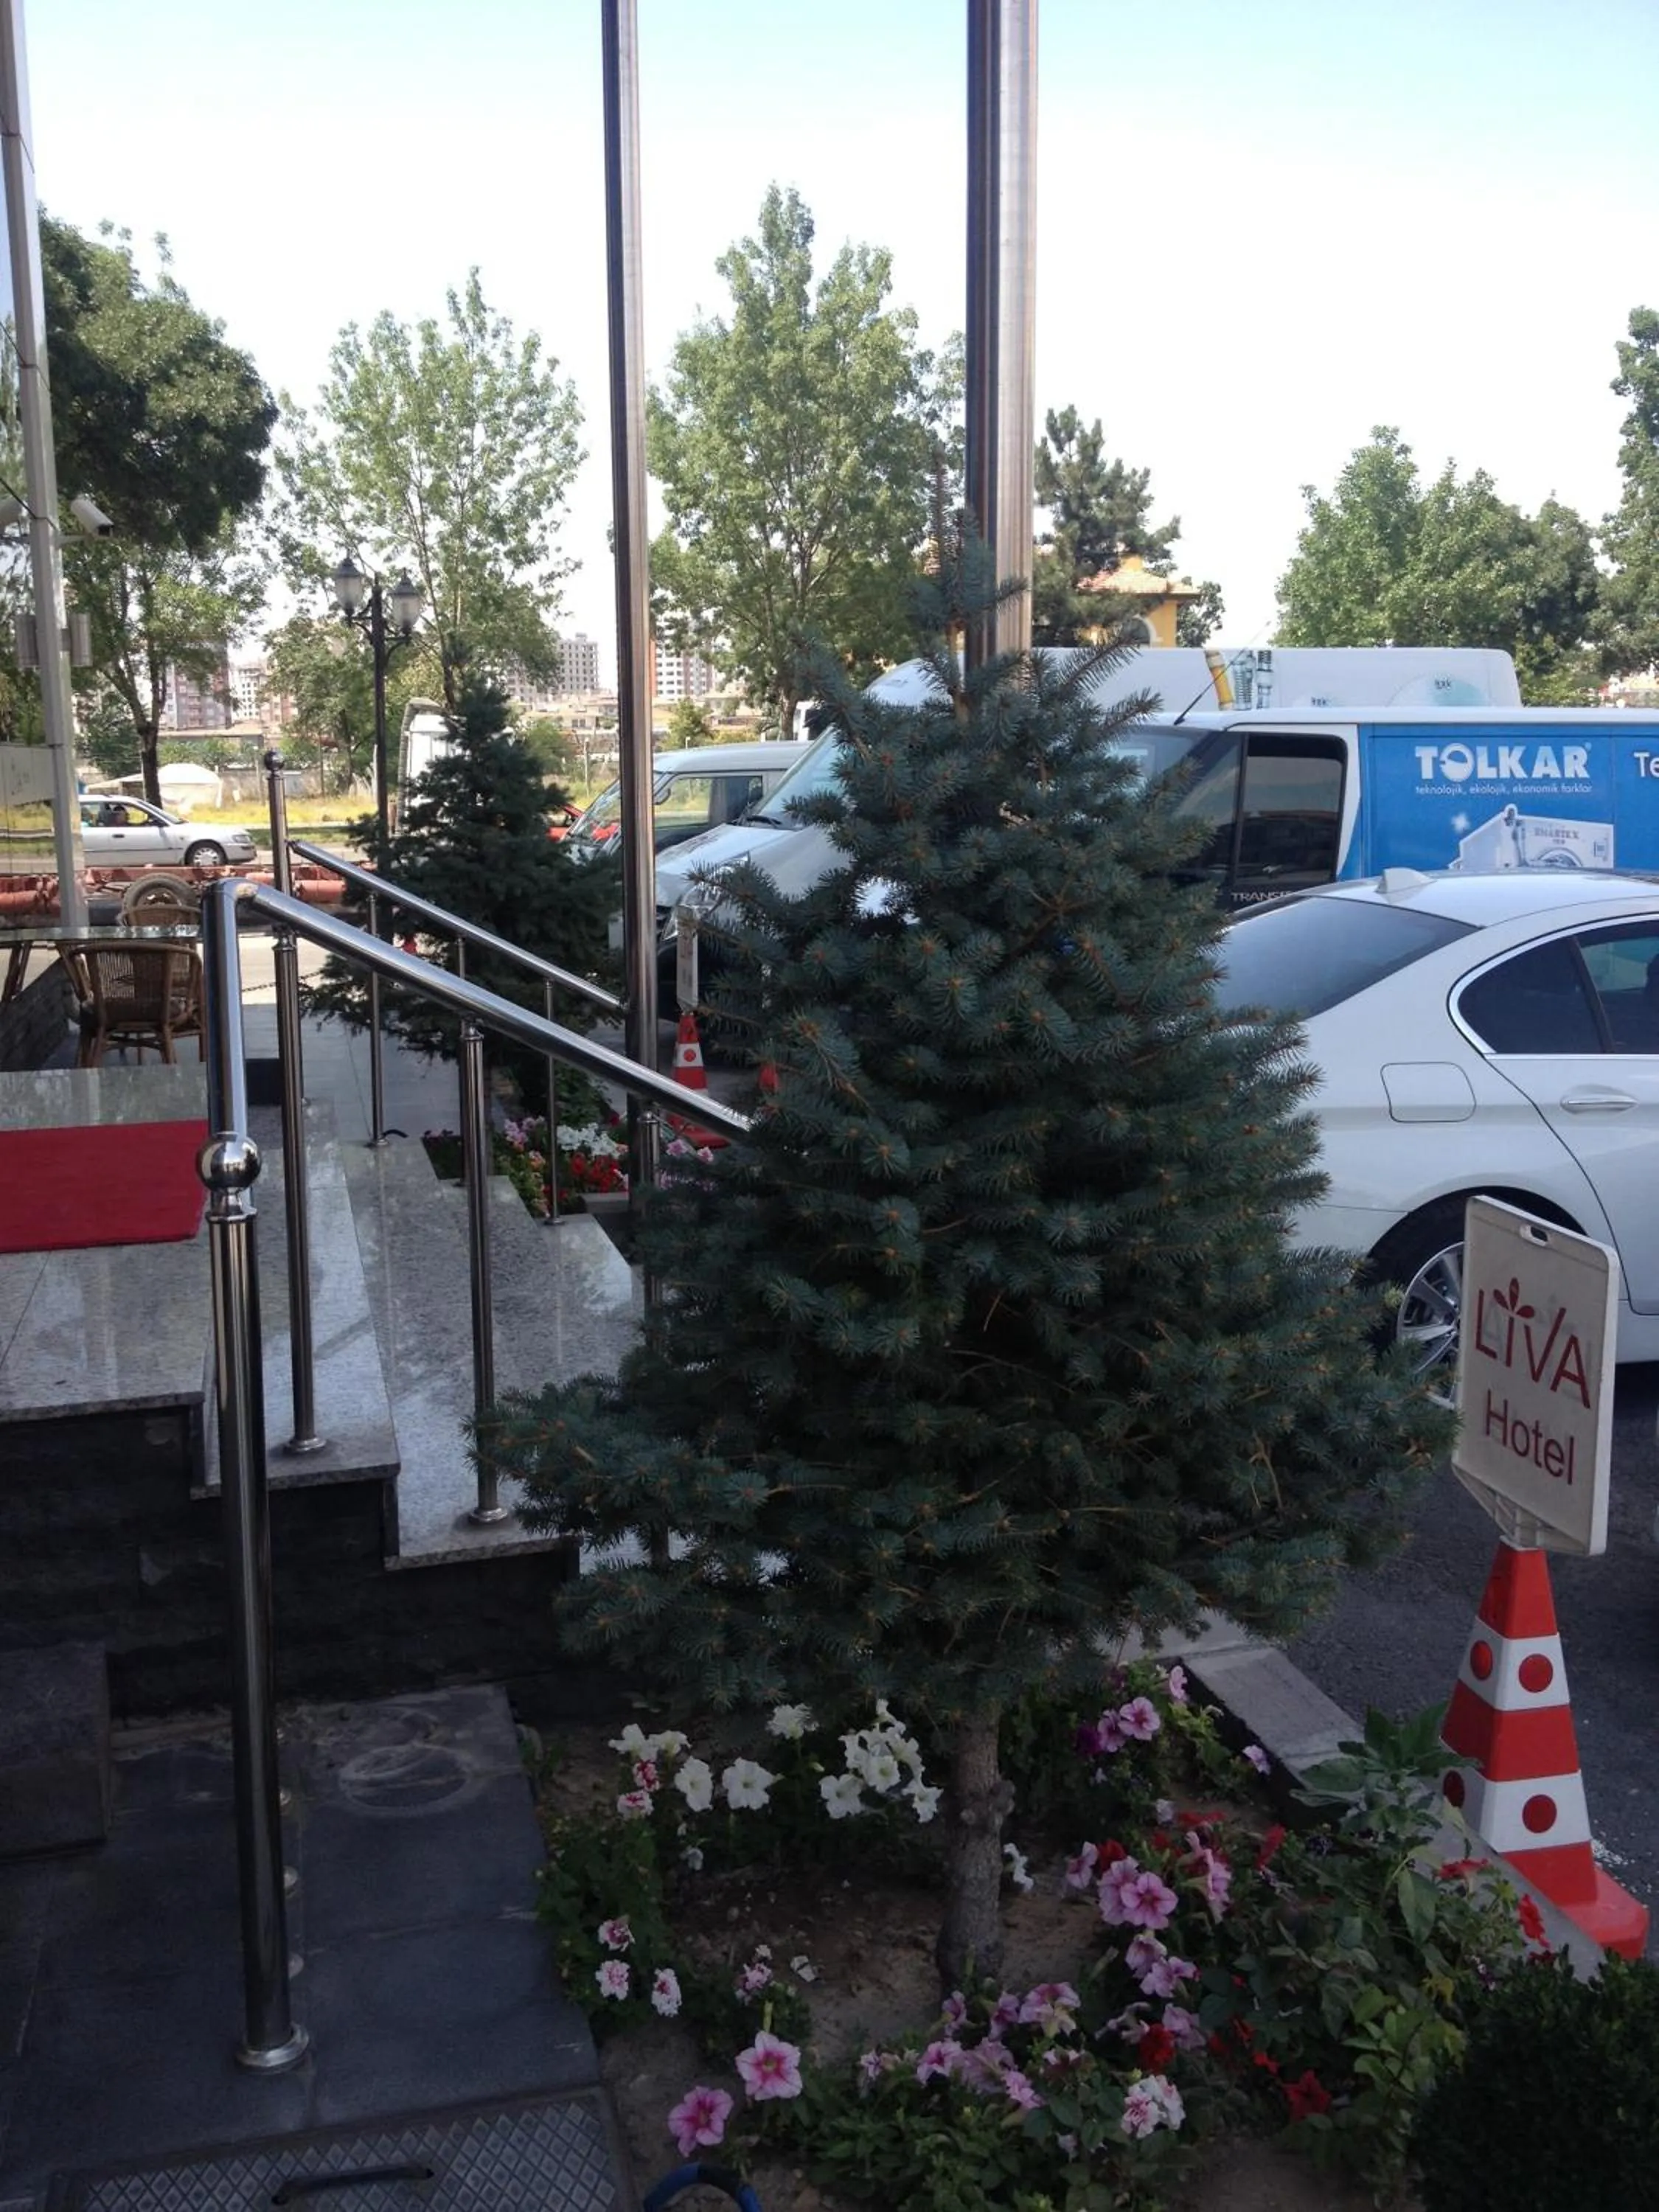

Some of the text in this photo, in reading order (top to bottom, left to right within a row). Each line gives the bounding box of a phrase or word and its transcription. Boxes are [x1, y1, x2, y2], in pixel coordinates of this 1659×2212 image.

[1415, 743, 1590, 782] TOLKAR
[1475, 1286, 1590, 1408] LIVA
[1486, 1388, 1574, 1485] Hotel
